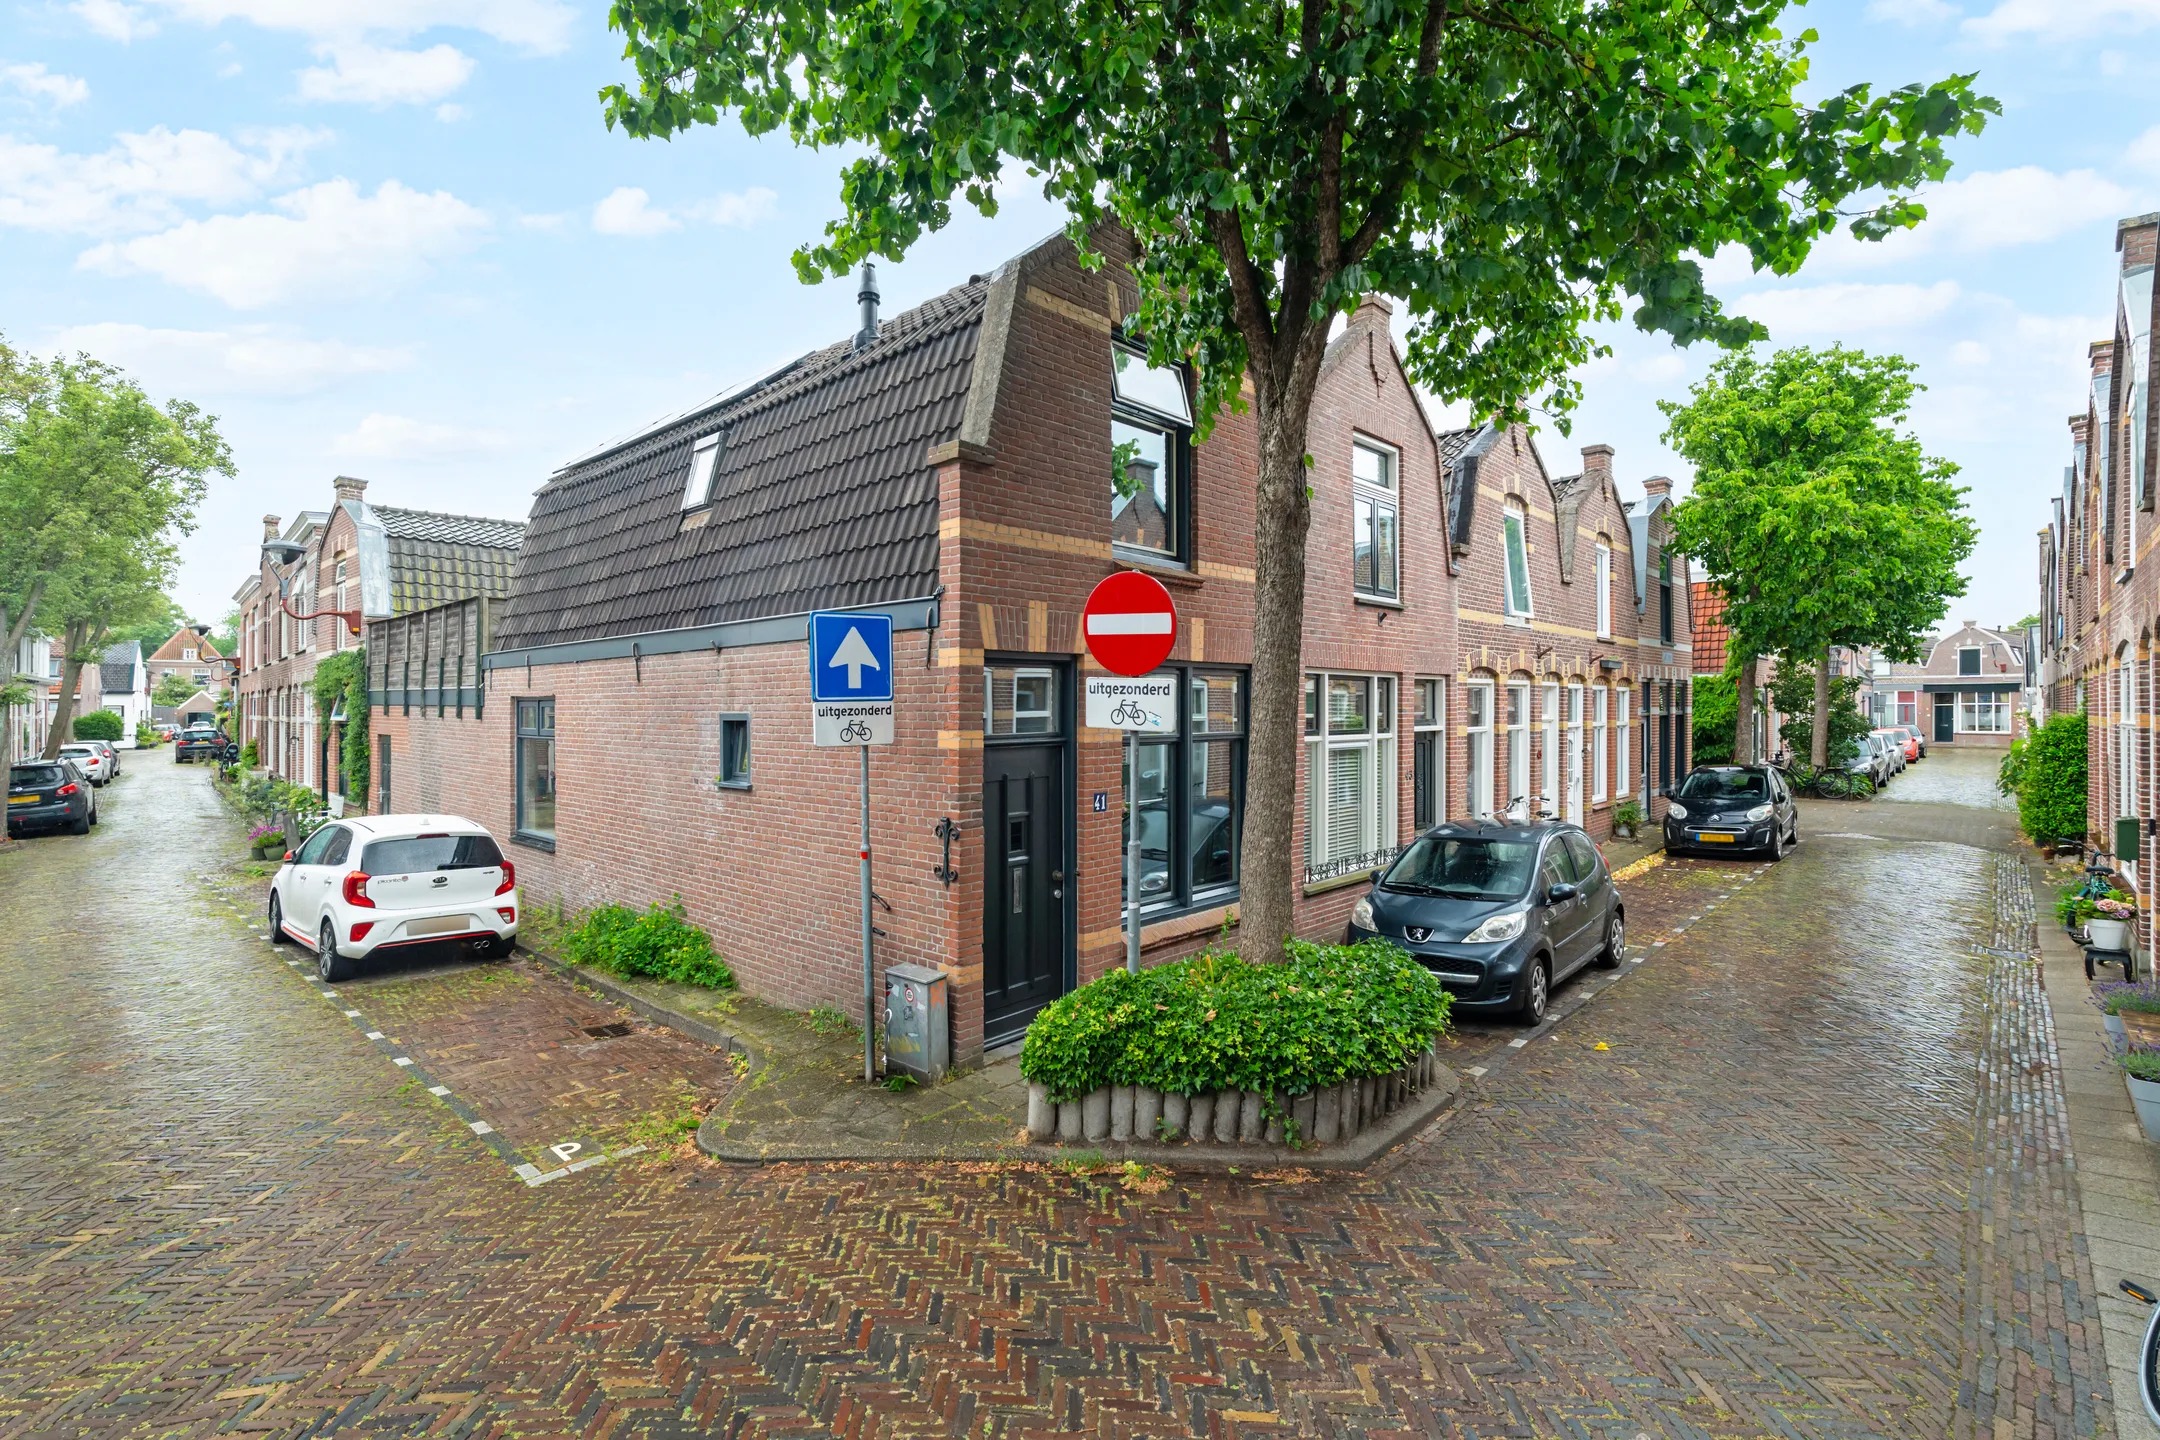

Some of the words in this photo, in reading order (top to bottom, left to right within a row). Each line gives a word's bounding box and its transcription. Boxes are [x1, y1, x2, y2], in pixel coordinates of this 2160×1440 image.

[1089, 682, 1170, 698] uitgezonderd
[818, 705, 892, 720] uitgezonderd
[1094, 795, 1105, 810] 41
[550, 1142, 582, 1161] P
